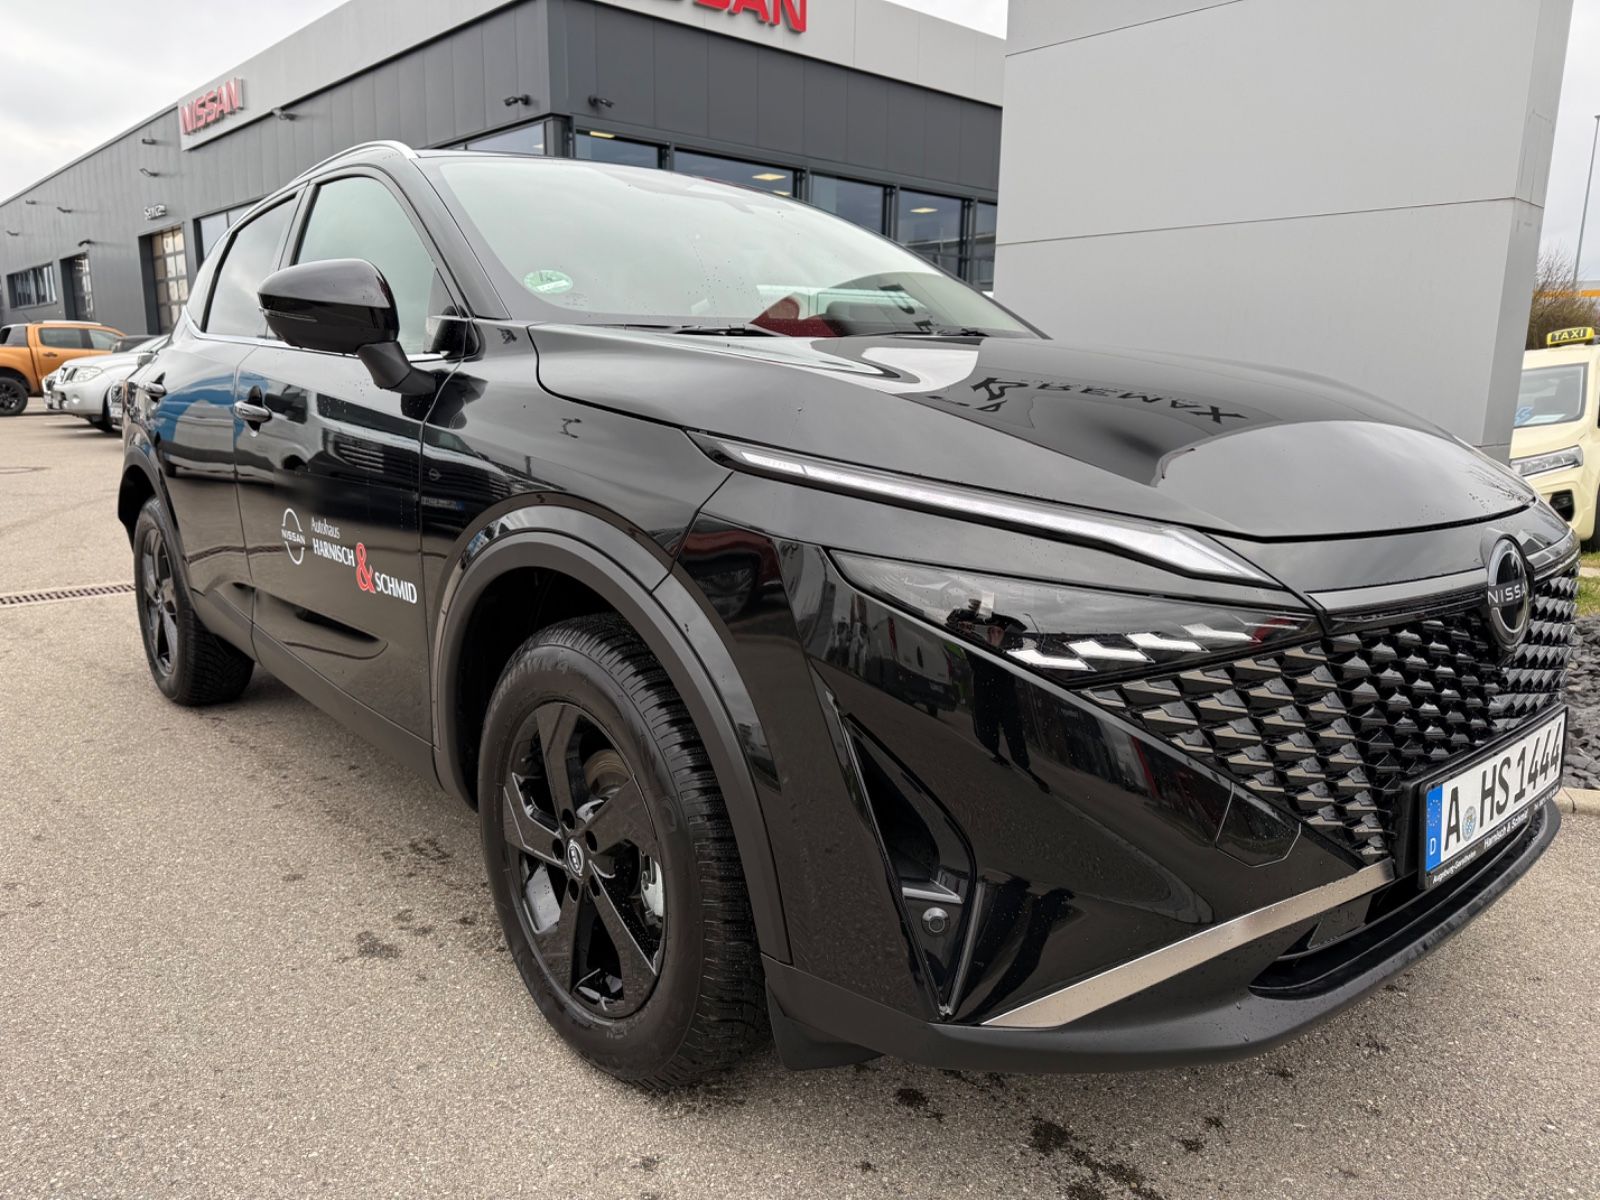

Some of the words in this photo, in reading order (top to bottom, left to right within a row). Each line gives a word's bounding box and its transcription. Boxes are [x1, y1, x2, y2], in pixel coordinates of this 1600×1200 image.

[181, 78, 241, 134] NISSAN
[1554, 329, 1584, 341] TAXI
[281, 529, 305, 545] NISSAN
[311, 517, 340, 539] Autohaus
[312, 538, 356, 567] HARNISCH
[355, 542, 376, 594] &
[374, 571, 418, 604] SCHMID
[1487, 582, 1526, 606] NISSA
[1444, 786, 1461, 851] A
